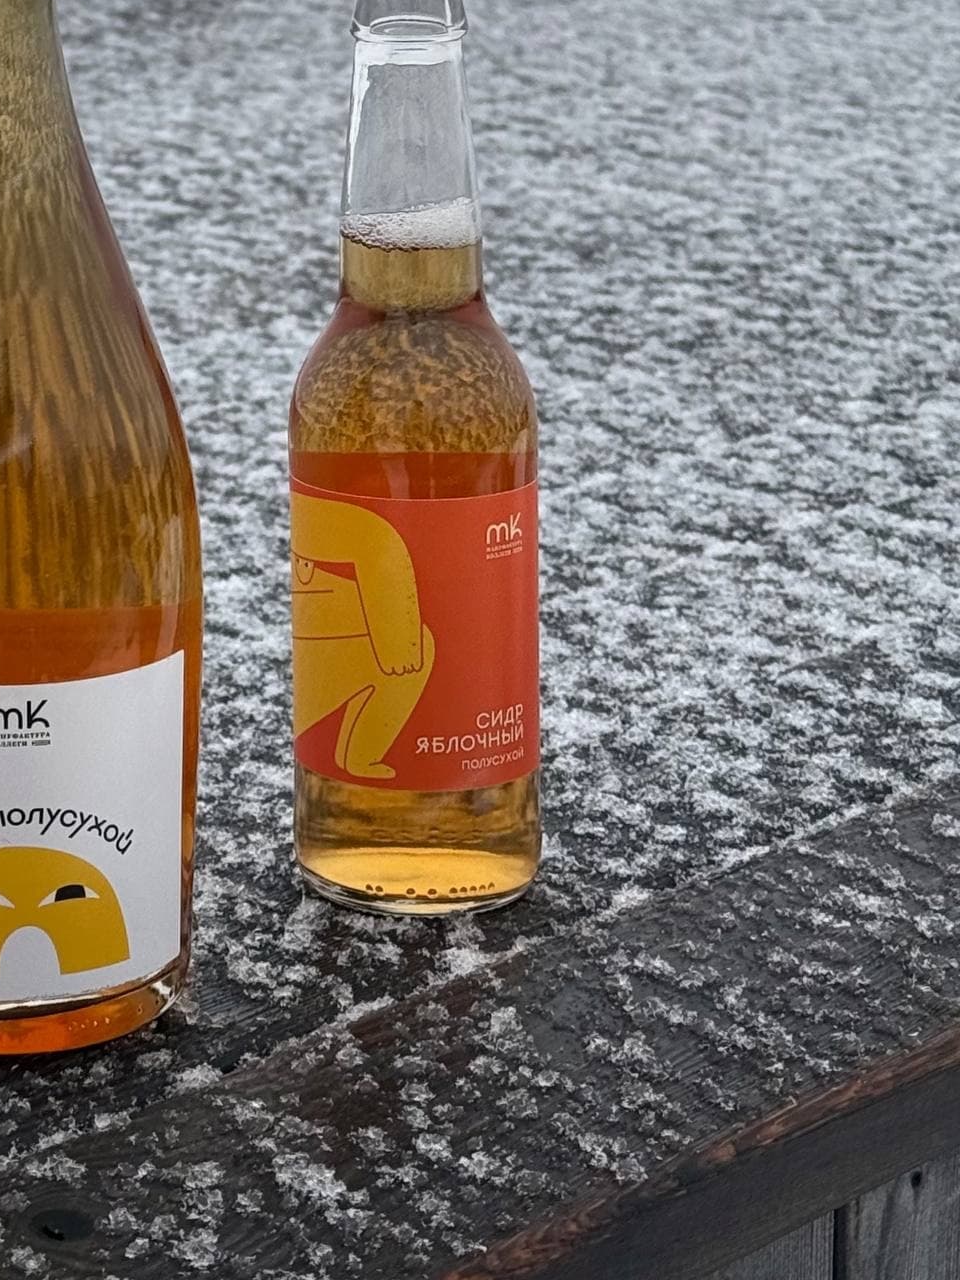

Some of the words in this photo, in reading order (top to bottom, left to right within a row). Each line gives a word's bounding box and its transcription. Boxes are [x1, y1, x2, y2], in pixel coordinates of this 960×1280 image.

[476, 704, 523, 729] СИДР
[415, 720, 524, 754] ЯБЛОЧНЫЙ
[461, 746, 524, 771] ПОЛУСУХОЙ
